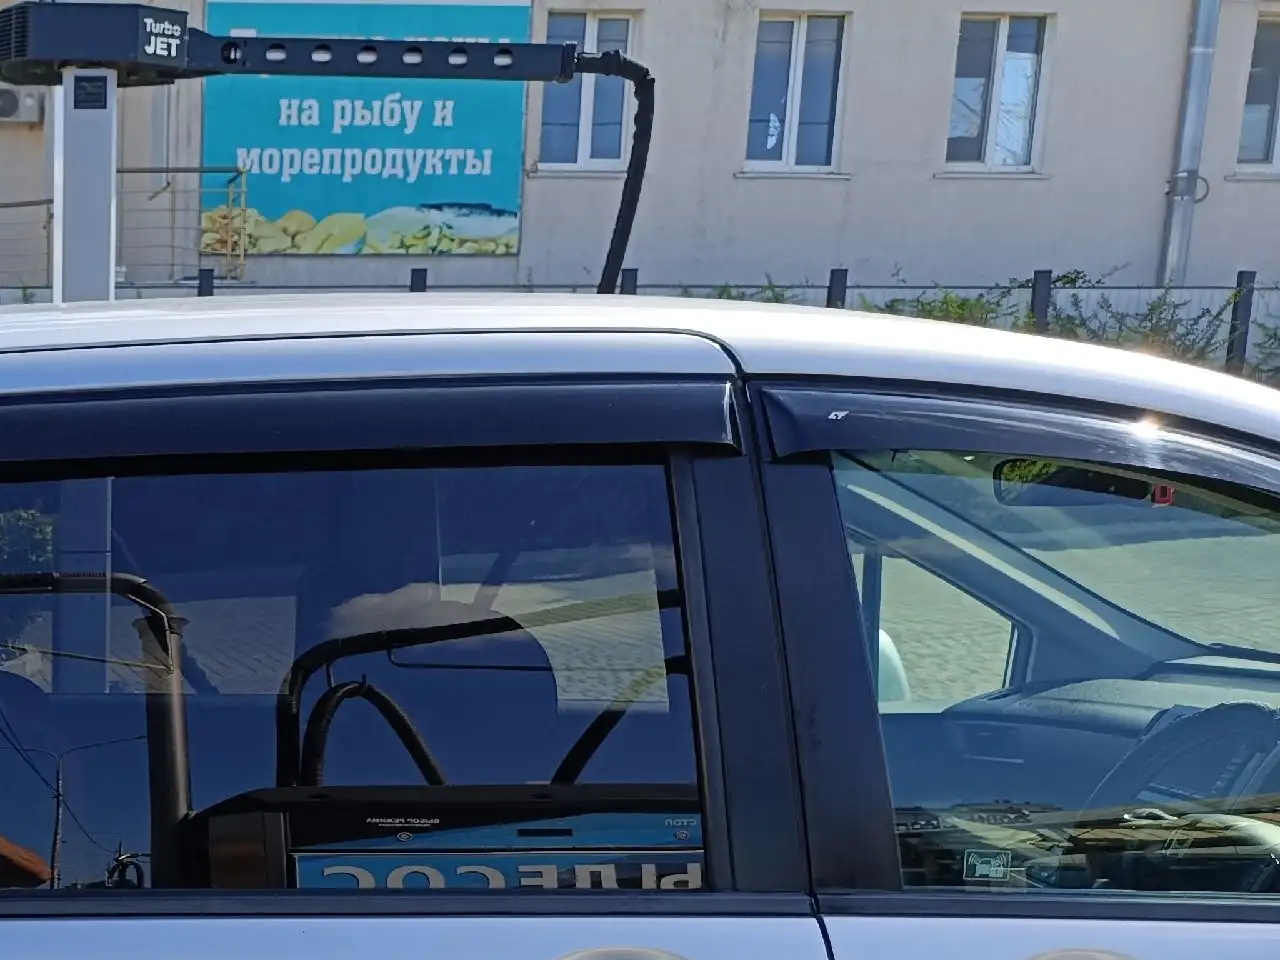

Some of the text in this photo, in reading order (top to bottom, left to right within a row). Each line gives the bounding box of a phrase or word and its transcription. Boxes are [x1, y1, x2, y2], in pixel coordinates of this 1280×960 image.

[143, 18, 182, 37] Turbo
[144, 35, 181, 57] JET
[278, 92, 455, 134] на рыбу и
[236, 147, 493, 183] морепродукты
